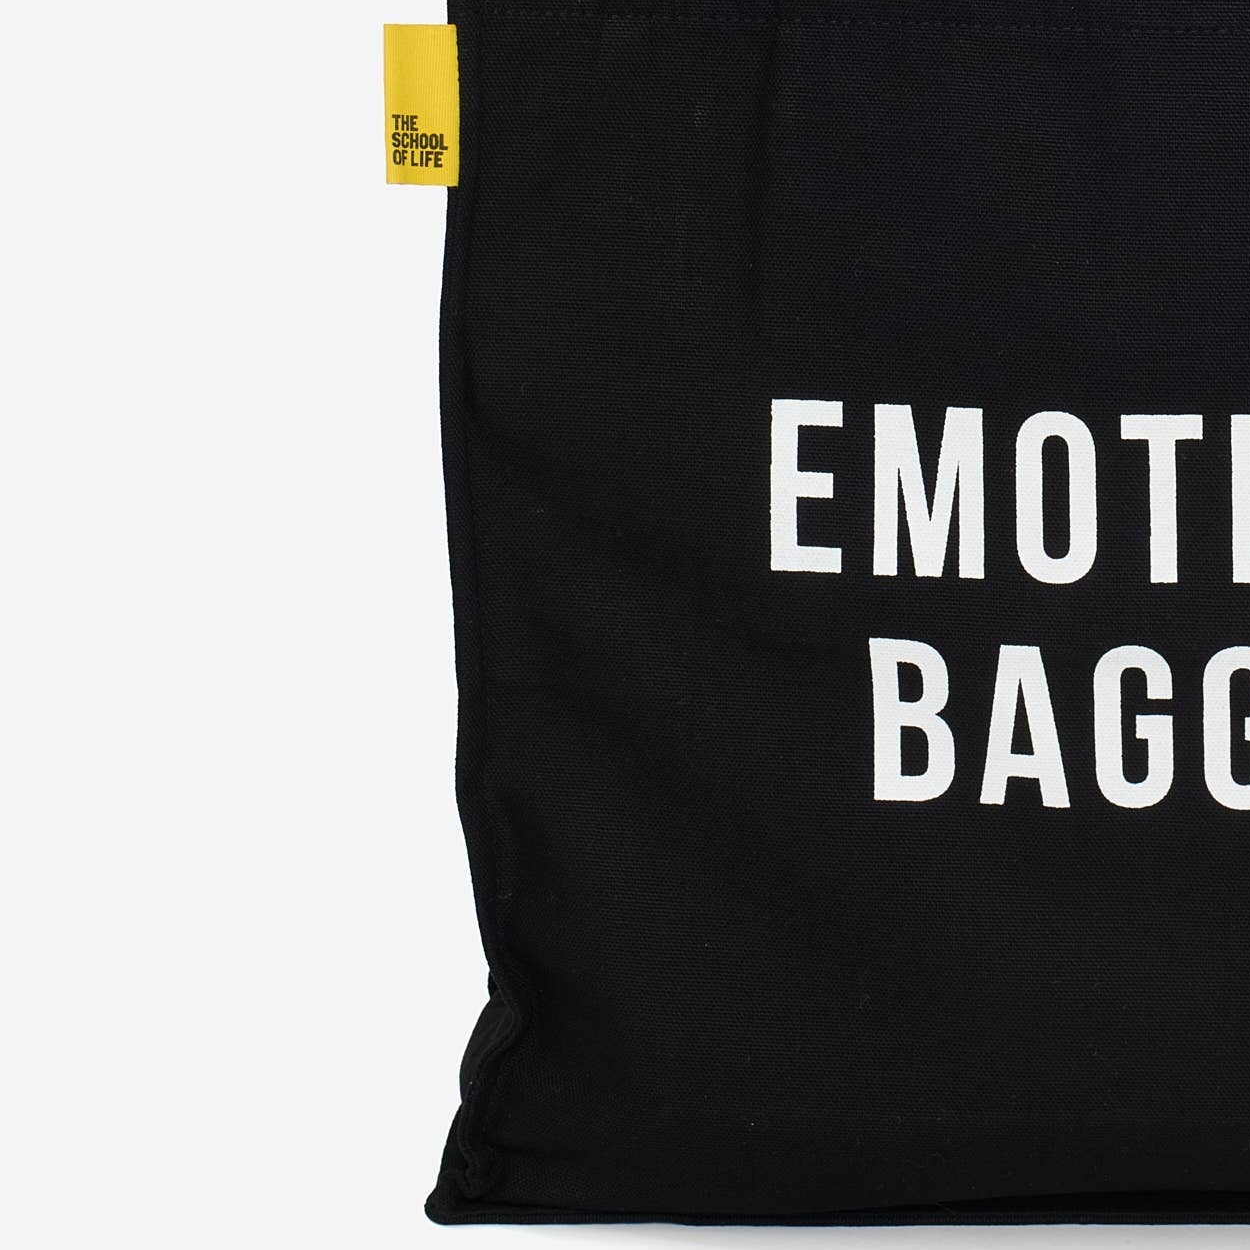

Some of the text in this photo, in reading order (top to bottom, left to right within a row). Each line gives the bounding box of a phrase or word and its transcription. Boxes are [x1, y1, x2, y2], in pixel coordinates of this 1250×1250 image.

[392, 114, 418, 132] THE
[392, 132, 448, 151] SCHOOL
[393, 150, 443, 168] OF LIFE
